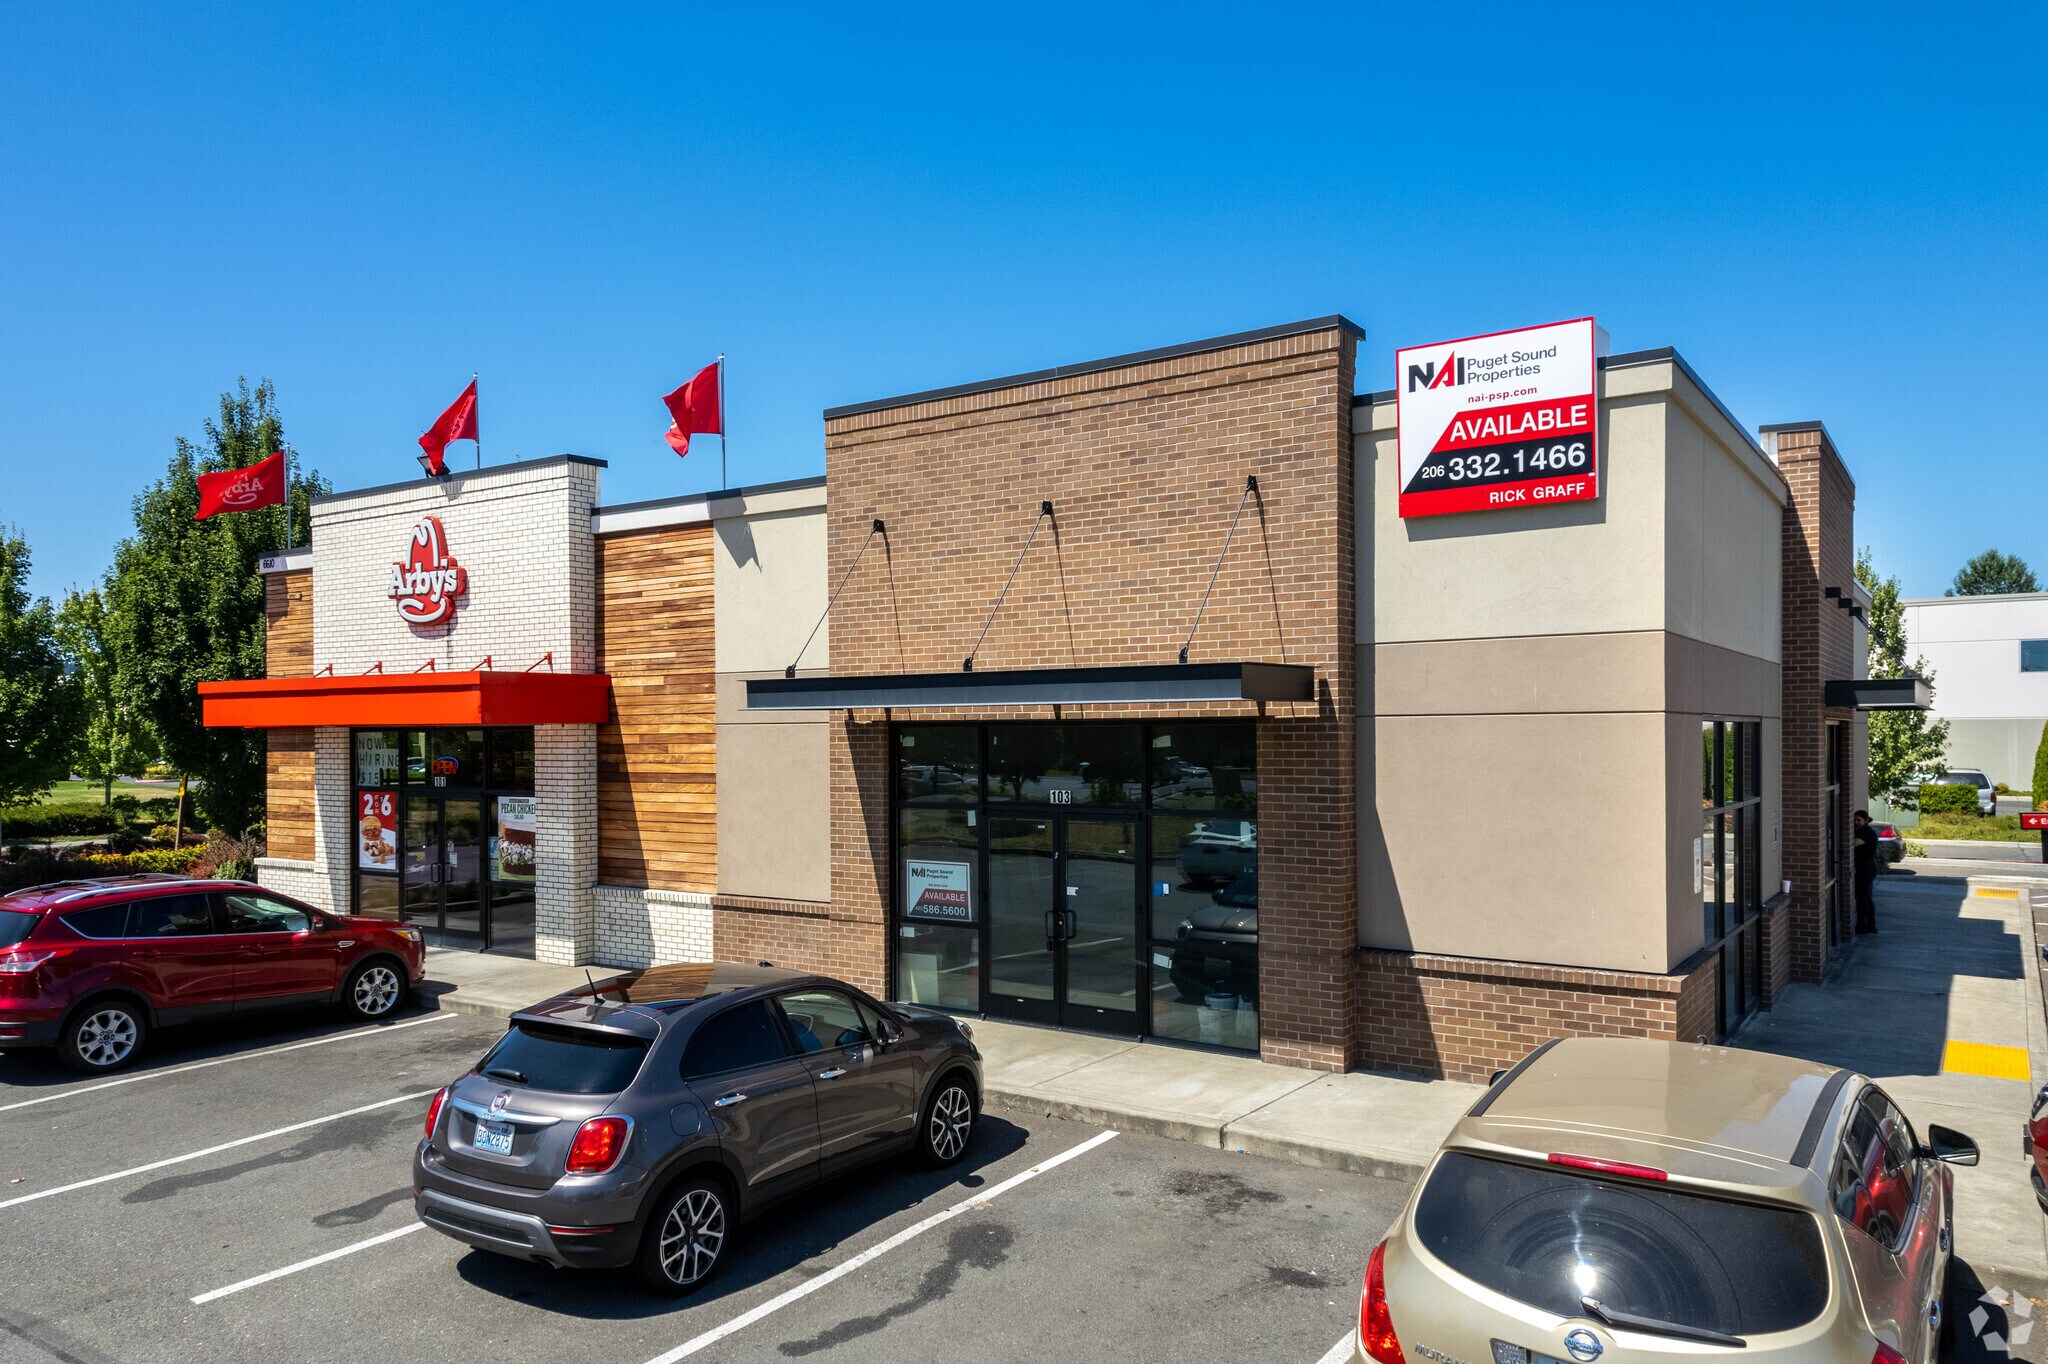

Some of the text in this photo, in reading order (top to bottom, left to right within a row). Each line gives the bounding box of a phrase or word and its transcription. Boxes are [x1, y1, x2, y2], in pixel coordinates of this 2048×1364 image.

[1467, 345, 1557, 371] Puget Sound
[1408, 350, 1465, 393] NAI
[1467, 363, 1541, 384] Properties
[1468, 386, 1538, 404] nai-psp.com
[1450, 404, 1588, 442] AVAILABLE
[1421, 442, 1586, 481] 206 332.1466
[1489, 482, 1586, 504] RICK GRAFF
[387, 558, 458, 603] Arby's
[359, 738, 382, 750] NOW
[431, 760, 457, 775] OPEN
[361, 772, 379, 785] $15
[363, 793, 374, 815] 2
[1051, 790, 1070, 804] 103
[501, 803, 535, 814] PECAN CHICKE
[911, 867, 926, 878] NAI
[924, 891, 965, 902] AVAILABLE
[923, 904, 966, 916] 586.5600
[1415, 1342, 1472, 1364] MURA
